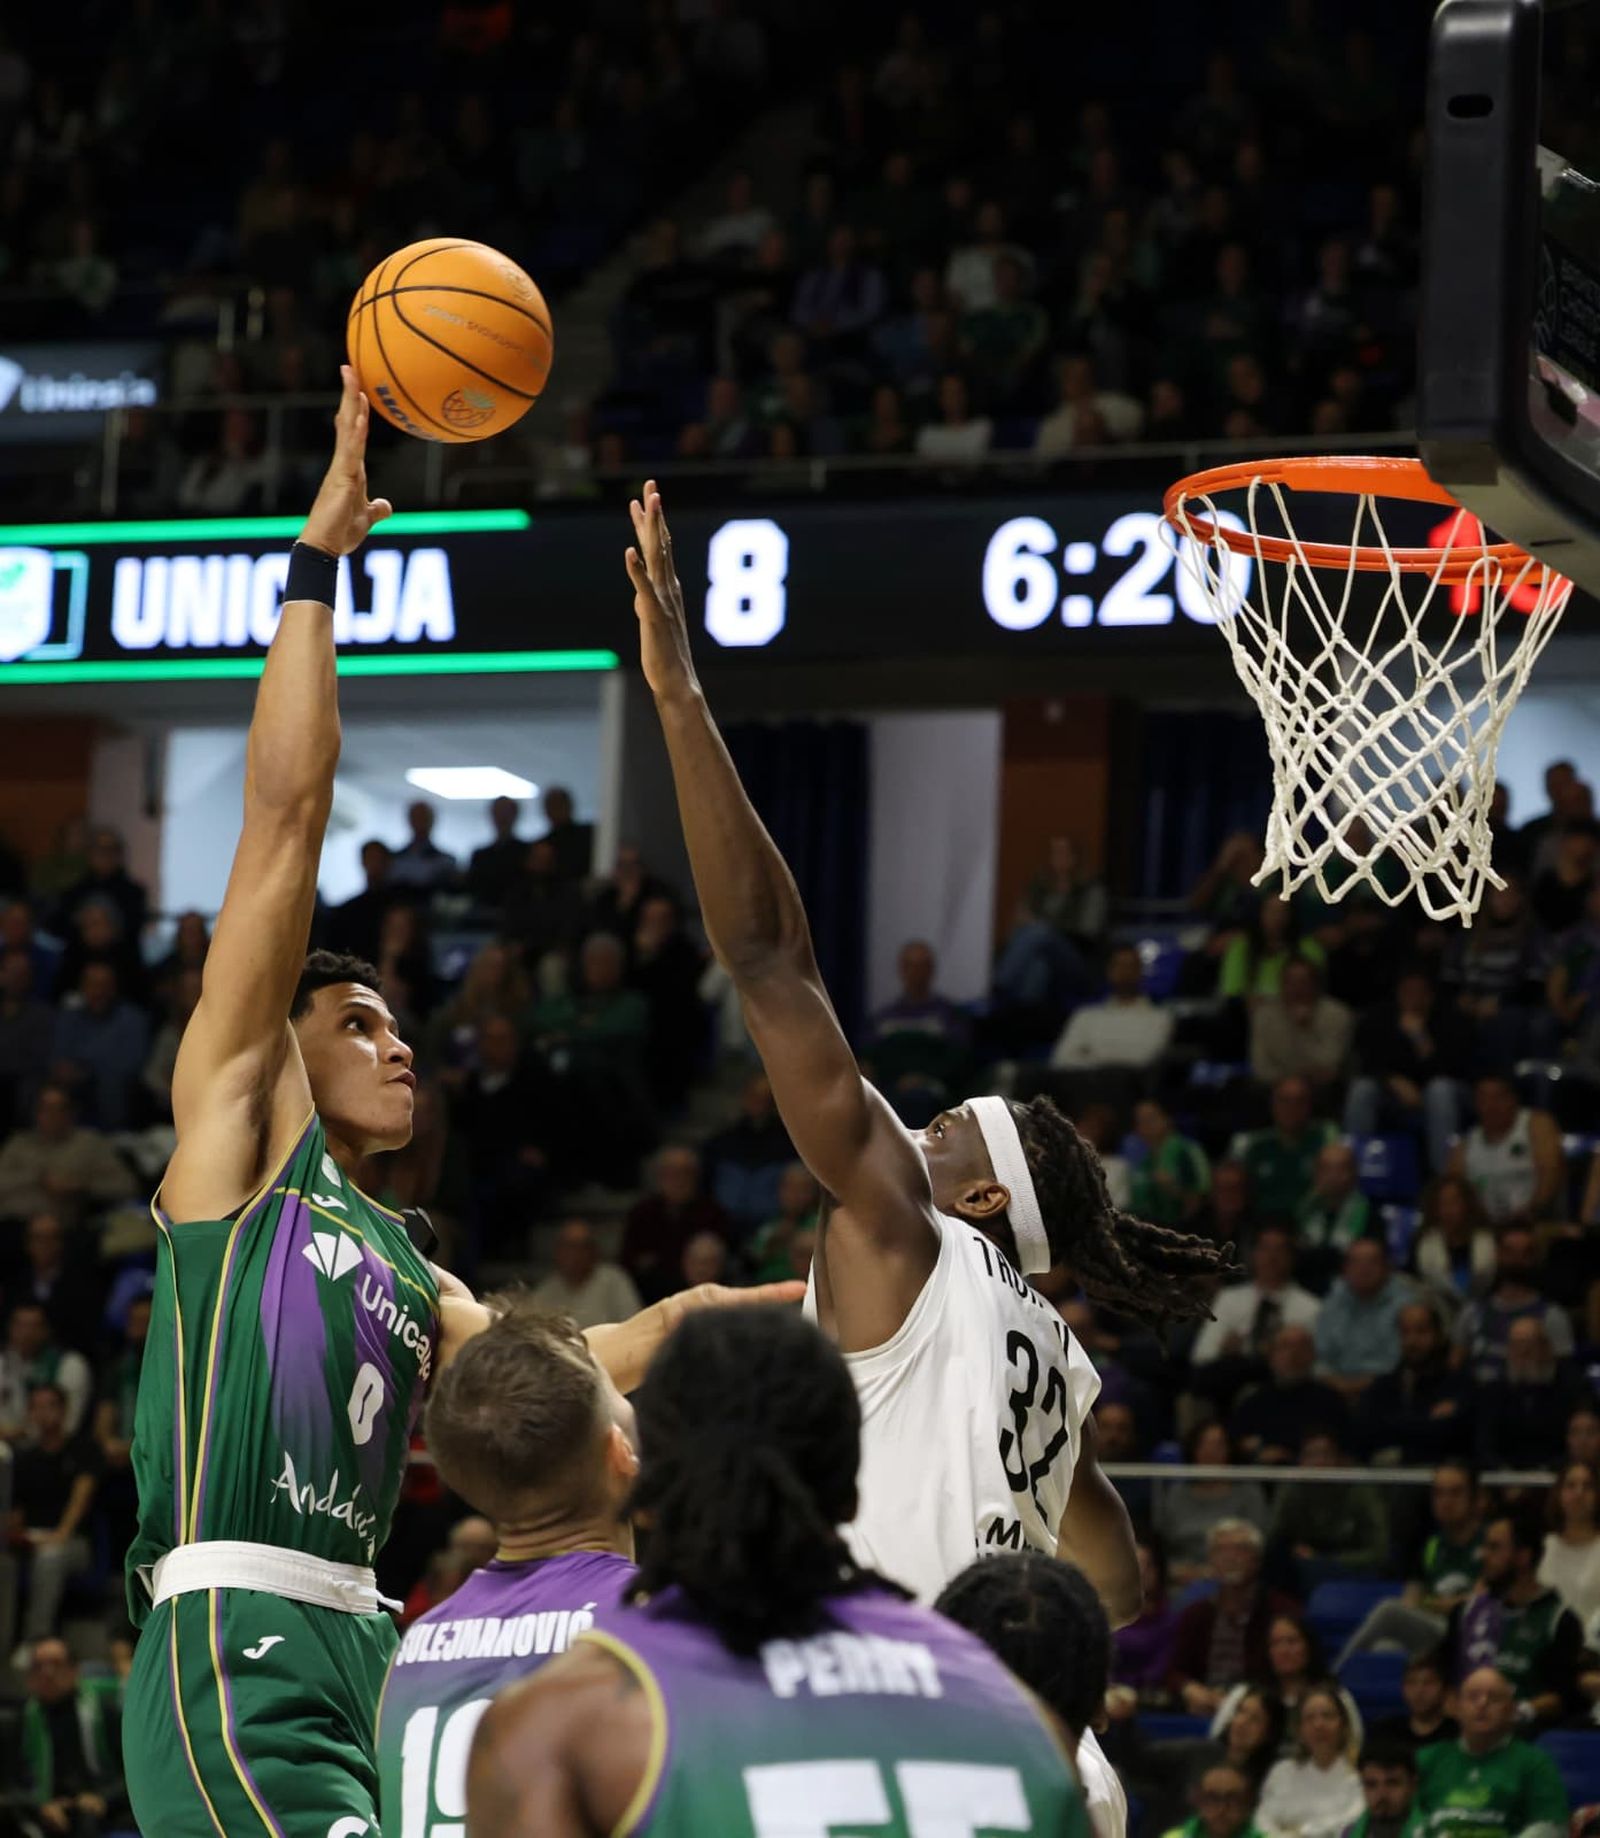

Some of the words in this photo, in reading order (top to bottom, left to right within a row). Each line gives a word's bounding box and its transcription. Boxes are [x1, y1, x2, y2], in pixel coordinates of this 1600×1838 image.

[704, 518, 789, 647] 8
[982, 510, 1252, 631] 6:20
[348, 1362, 384, 1446] 0
[760, 1630, 944, 1699] PERRY
